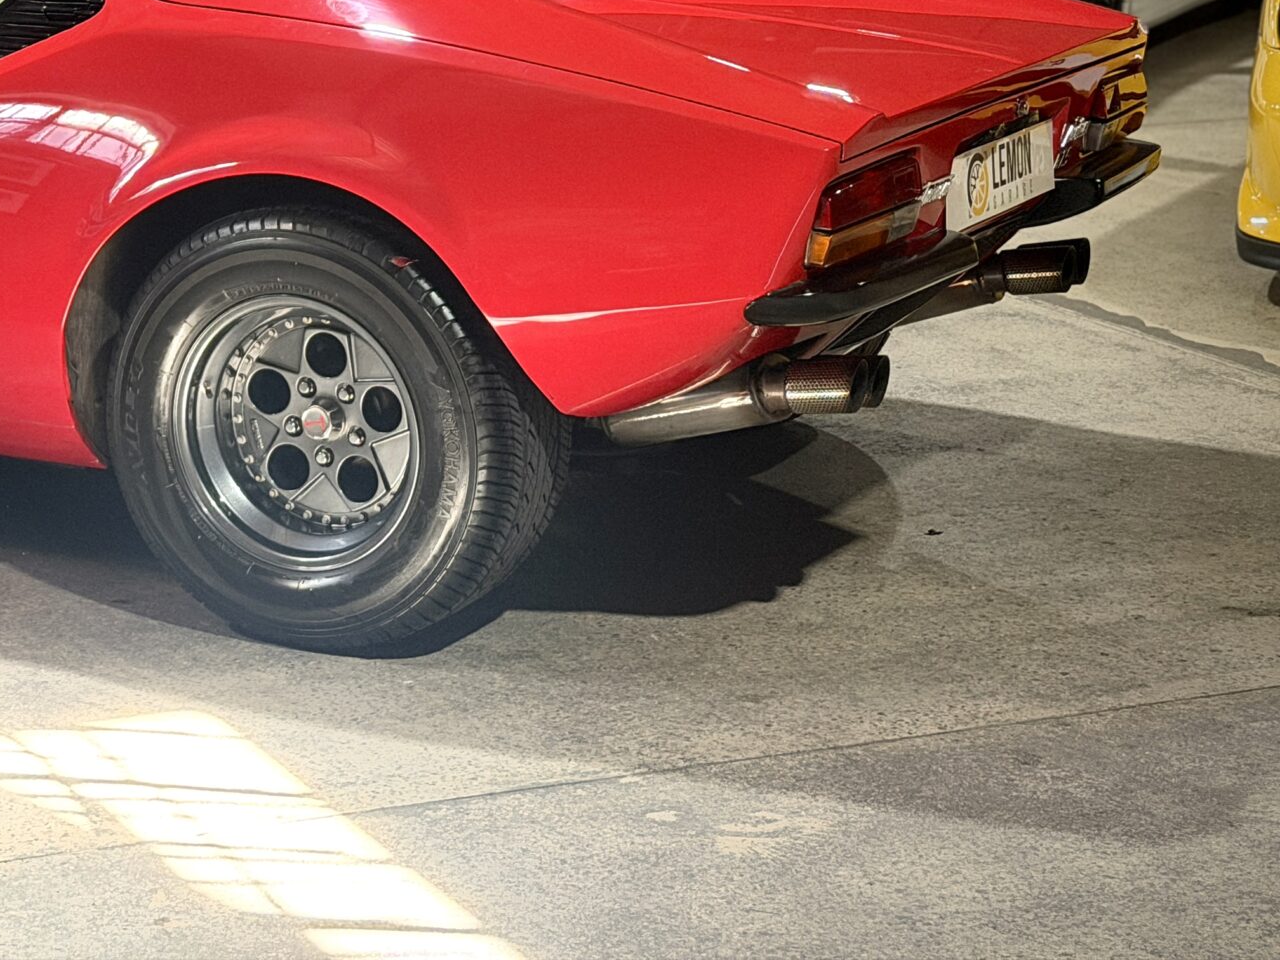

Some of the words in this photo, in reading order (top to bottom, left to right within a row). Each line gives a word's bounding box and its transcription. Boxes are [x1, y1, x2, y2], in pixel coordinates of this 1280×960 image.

[991, 131, 1032, 190] LEMON
[992, 178, 1034, 211] GARAGE
[437, 397, 461, 520] YOKOHAMA
